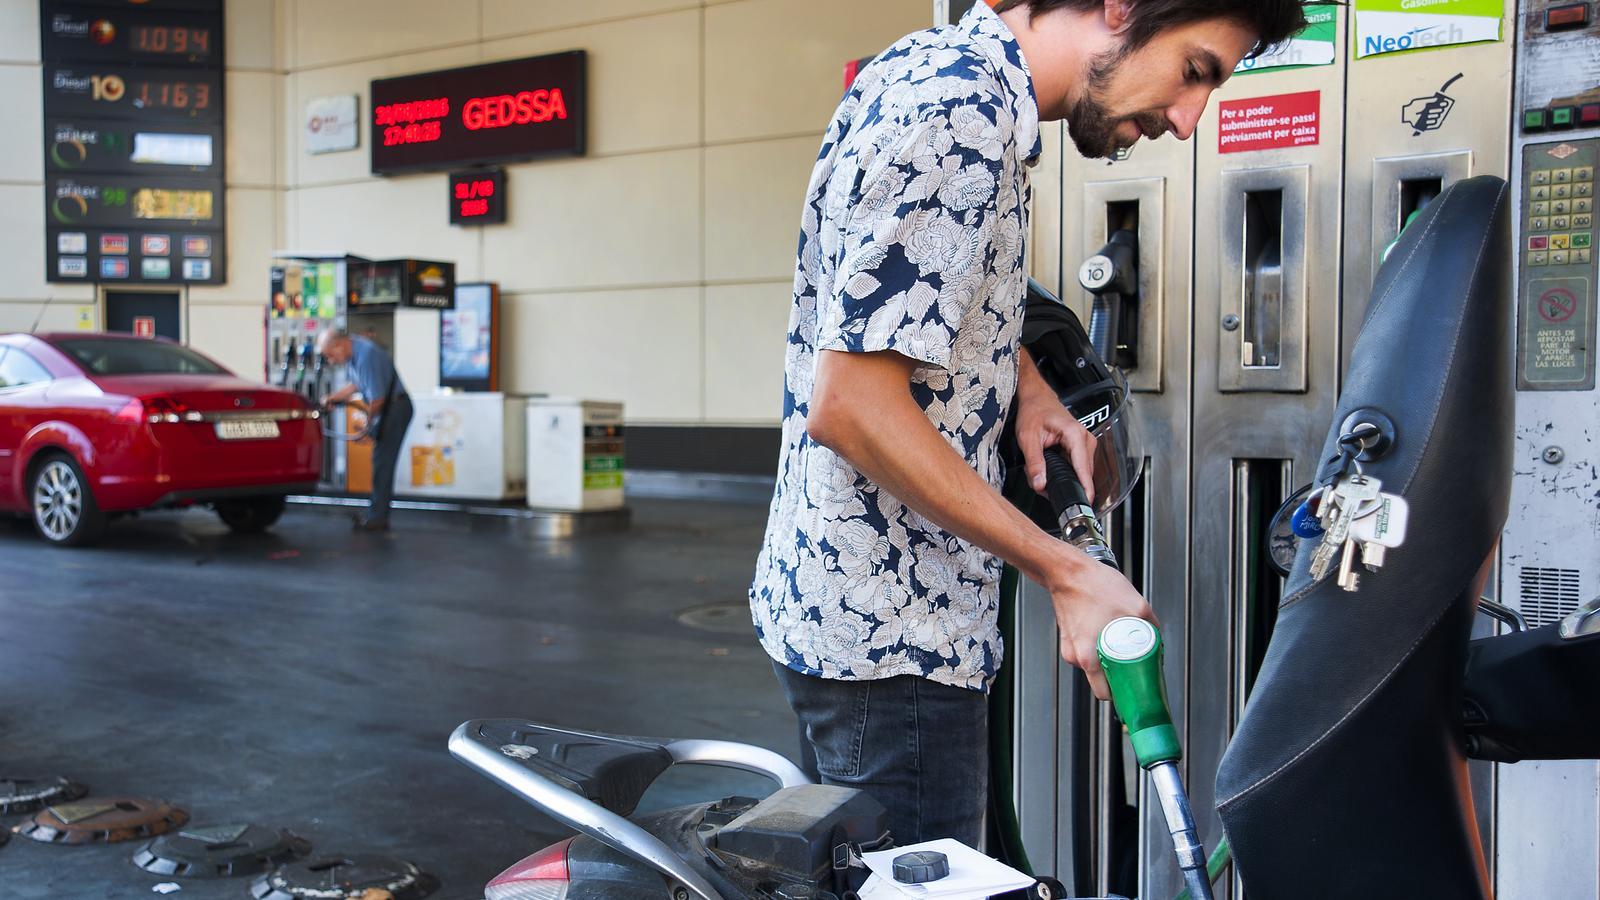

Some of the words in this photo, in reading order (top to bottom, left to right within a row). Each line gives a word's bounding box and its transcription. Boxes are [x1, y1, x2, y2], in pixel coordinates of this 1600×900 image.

[462, 88, 568, 131] GEDSSA
[1221, 109, 1237, 119] Per
[1246, 105, 1274, 118] poder
[1221, 117, 1291, 132] subministrar-se
[1292, 112, 1316, 125] passi
[1274, 128, 1290, 140] per
[1291, 126, 1316, 137] caixa
[1087, 268, 1104, 281] 10
